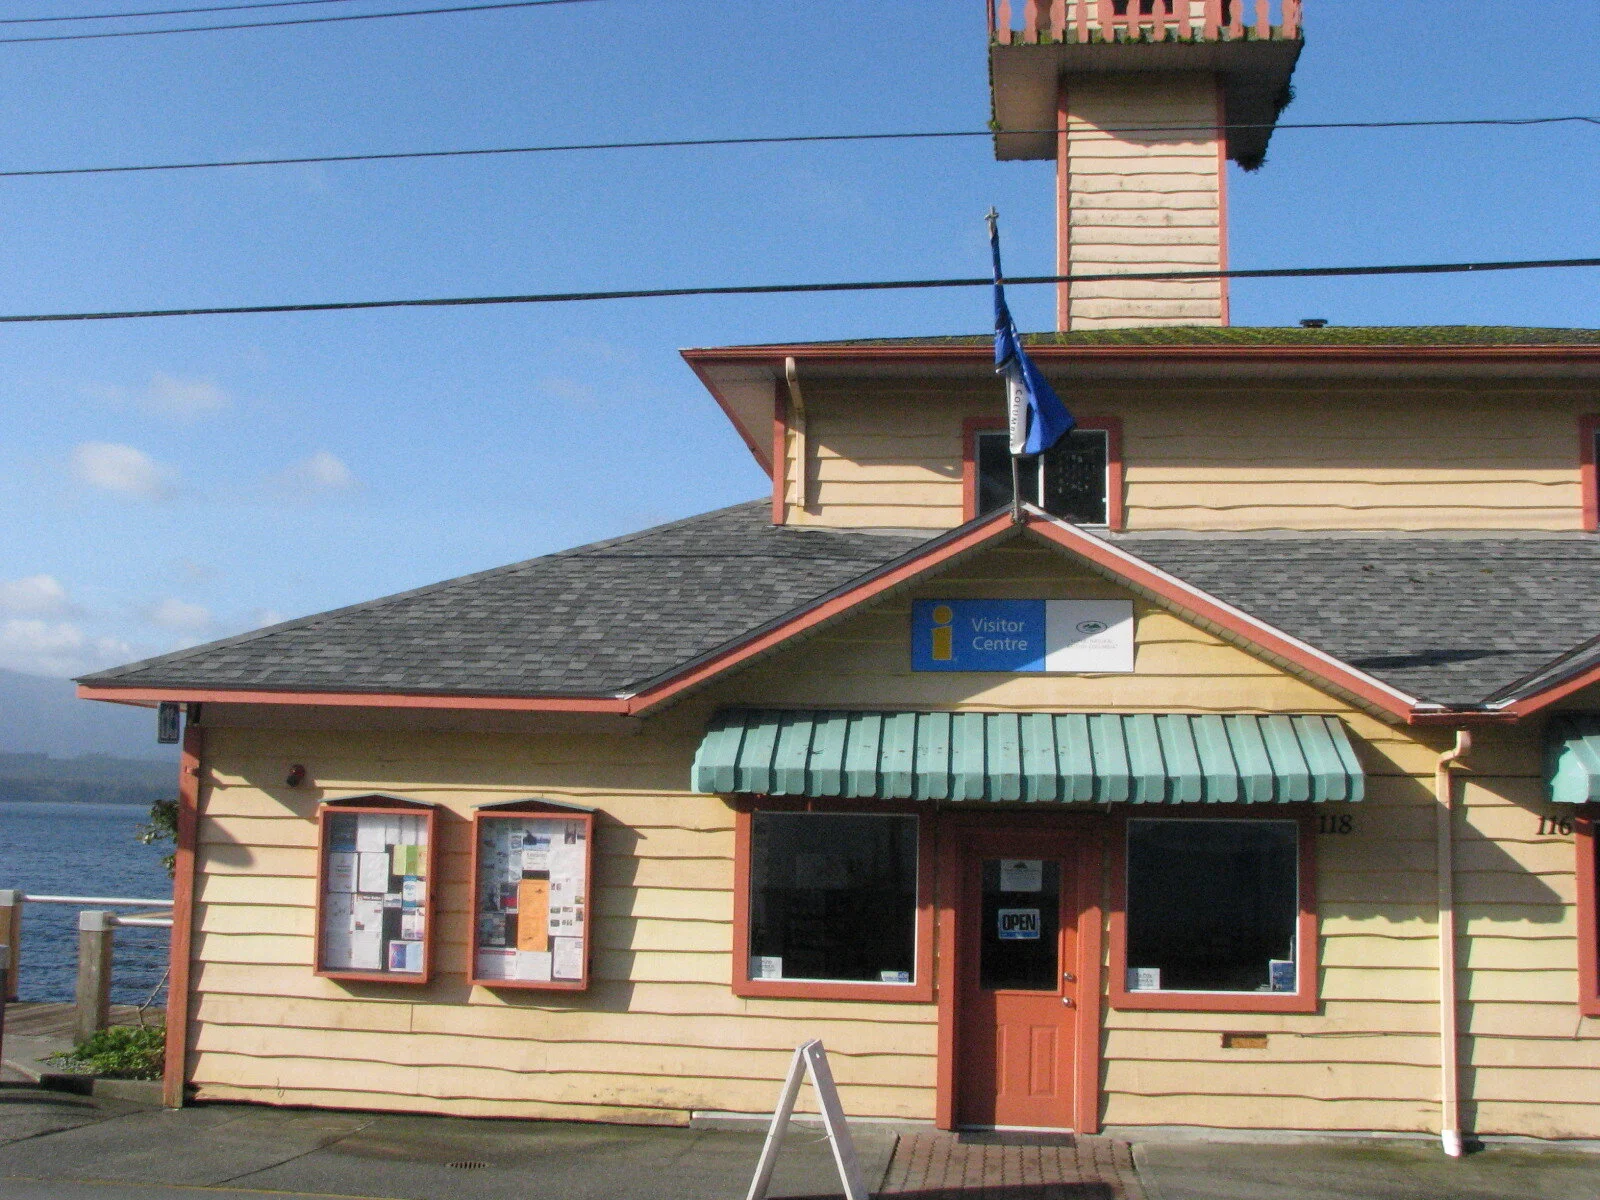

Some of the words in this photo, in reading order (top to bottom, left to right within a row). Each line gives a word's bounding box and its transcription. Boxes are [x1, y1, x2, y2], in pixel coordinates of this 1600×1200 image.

[971, 616, 1025, 633] Visitor
[972, 636, 1028, 651] Centre
[1318, 814, 1352, 835] 118
[1535, 815, 1573, 836] 116
[1002, 913, 1036, 931] OPEN
